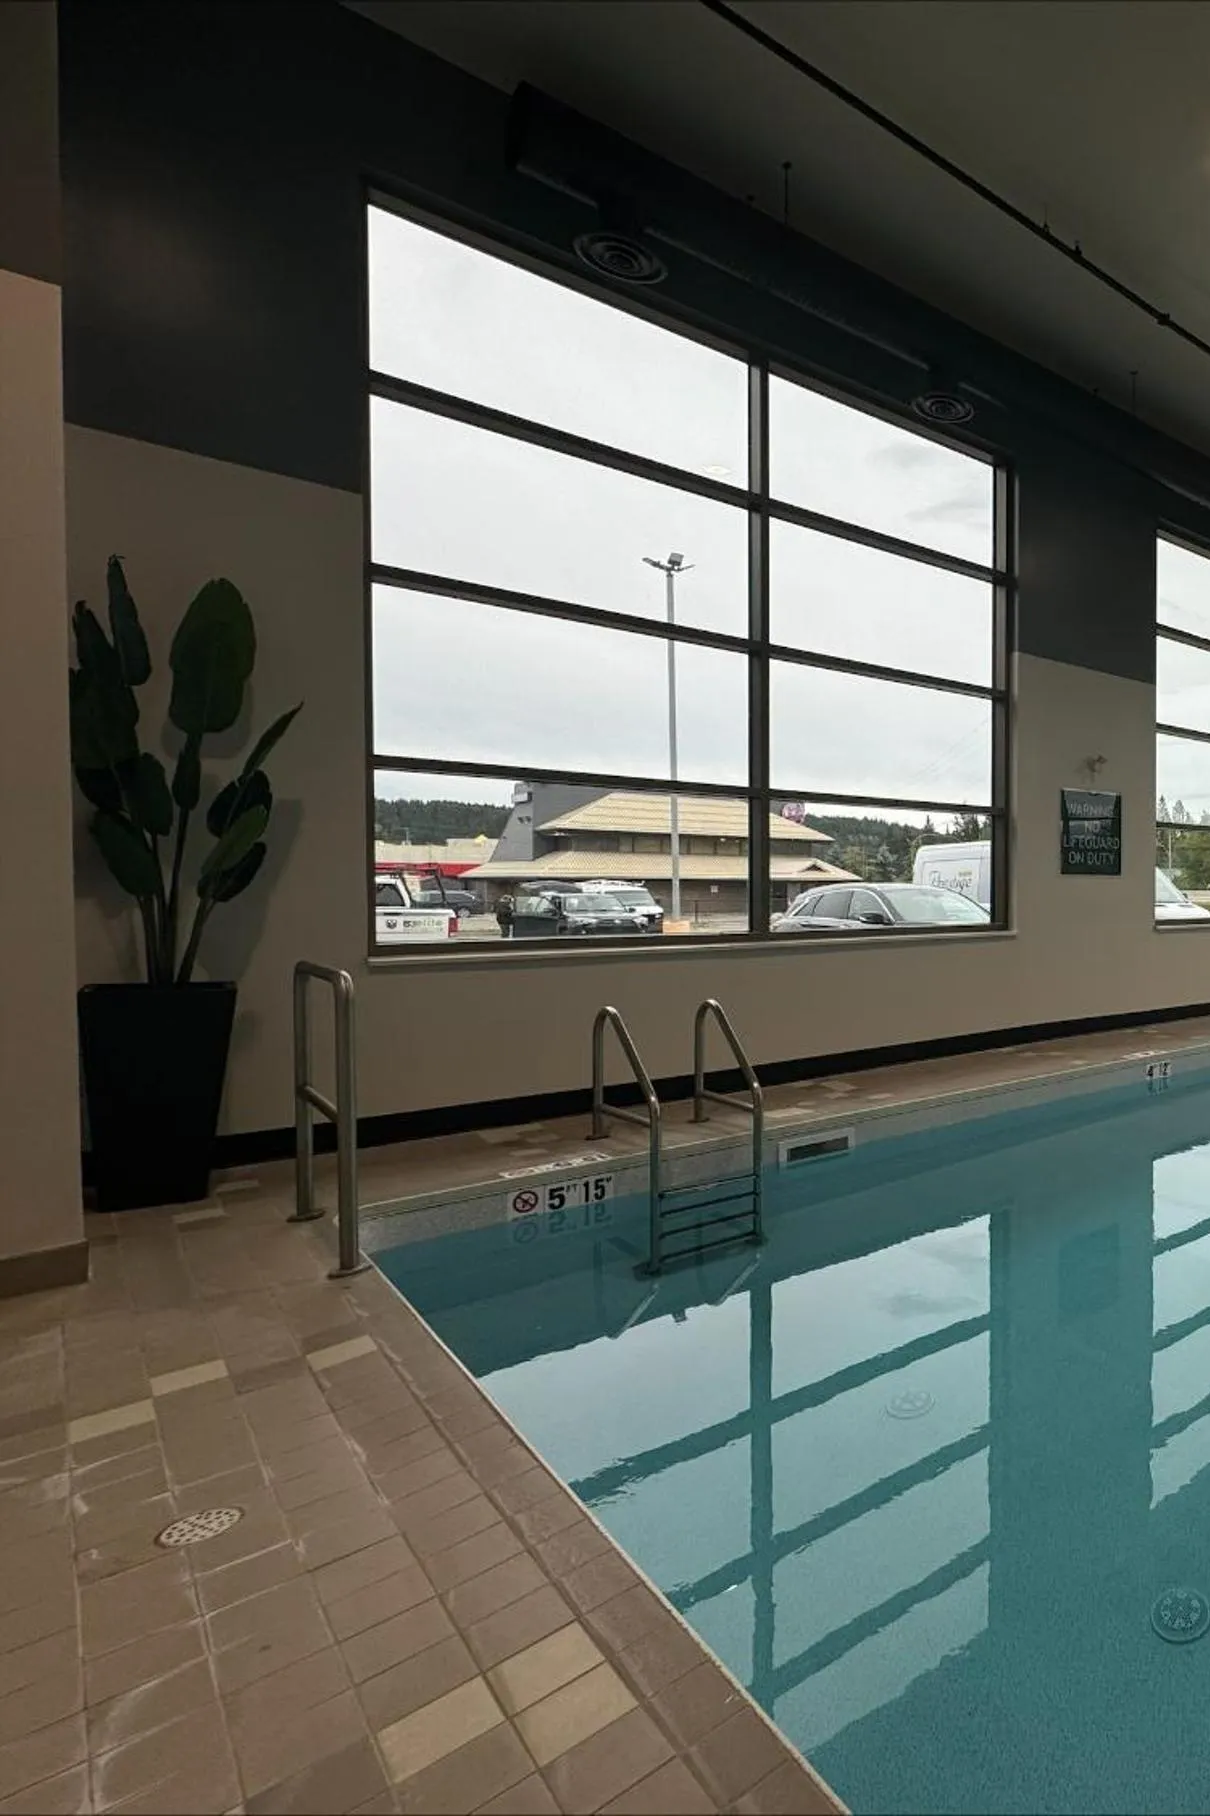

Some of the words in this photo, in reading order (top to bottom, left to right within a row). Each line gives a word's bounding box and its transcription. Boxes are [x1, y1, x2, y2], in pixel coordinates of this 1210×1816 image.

[1066, 801, 1115, 817] WARNING
[1084, 820, 1101, 833] NO
[1064, 835, 1120, 850] LIFEGUARD
[1069, 851, 1085, 865] ON
[1088, 852, 1115, 866] DUTY
